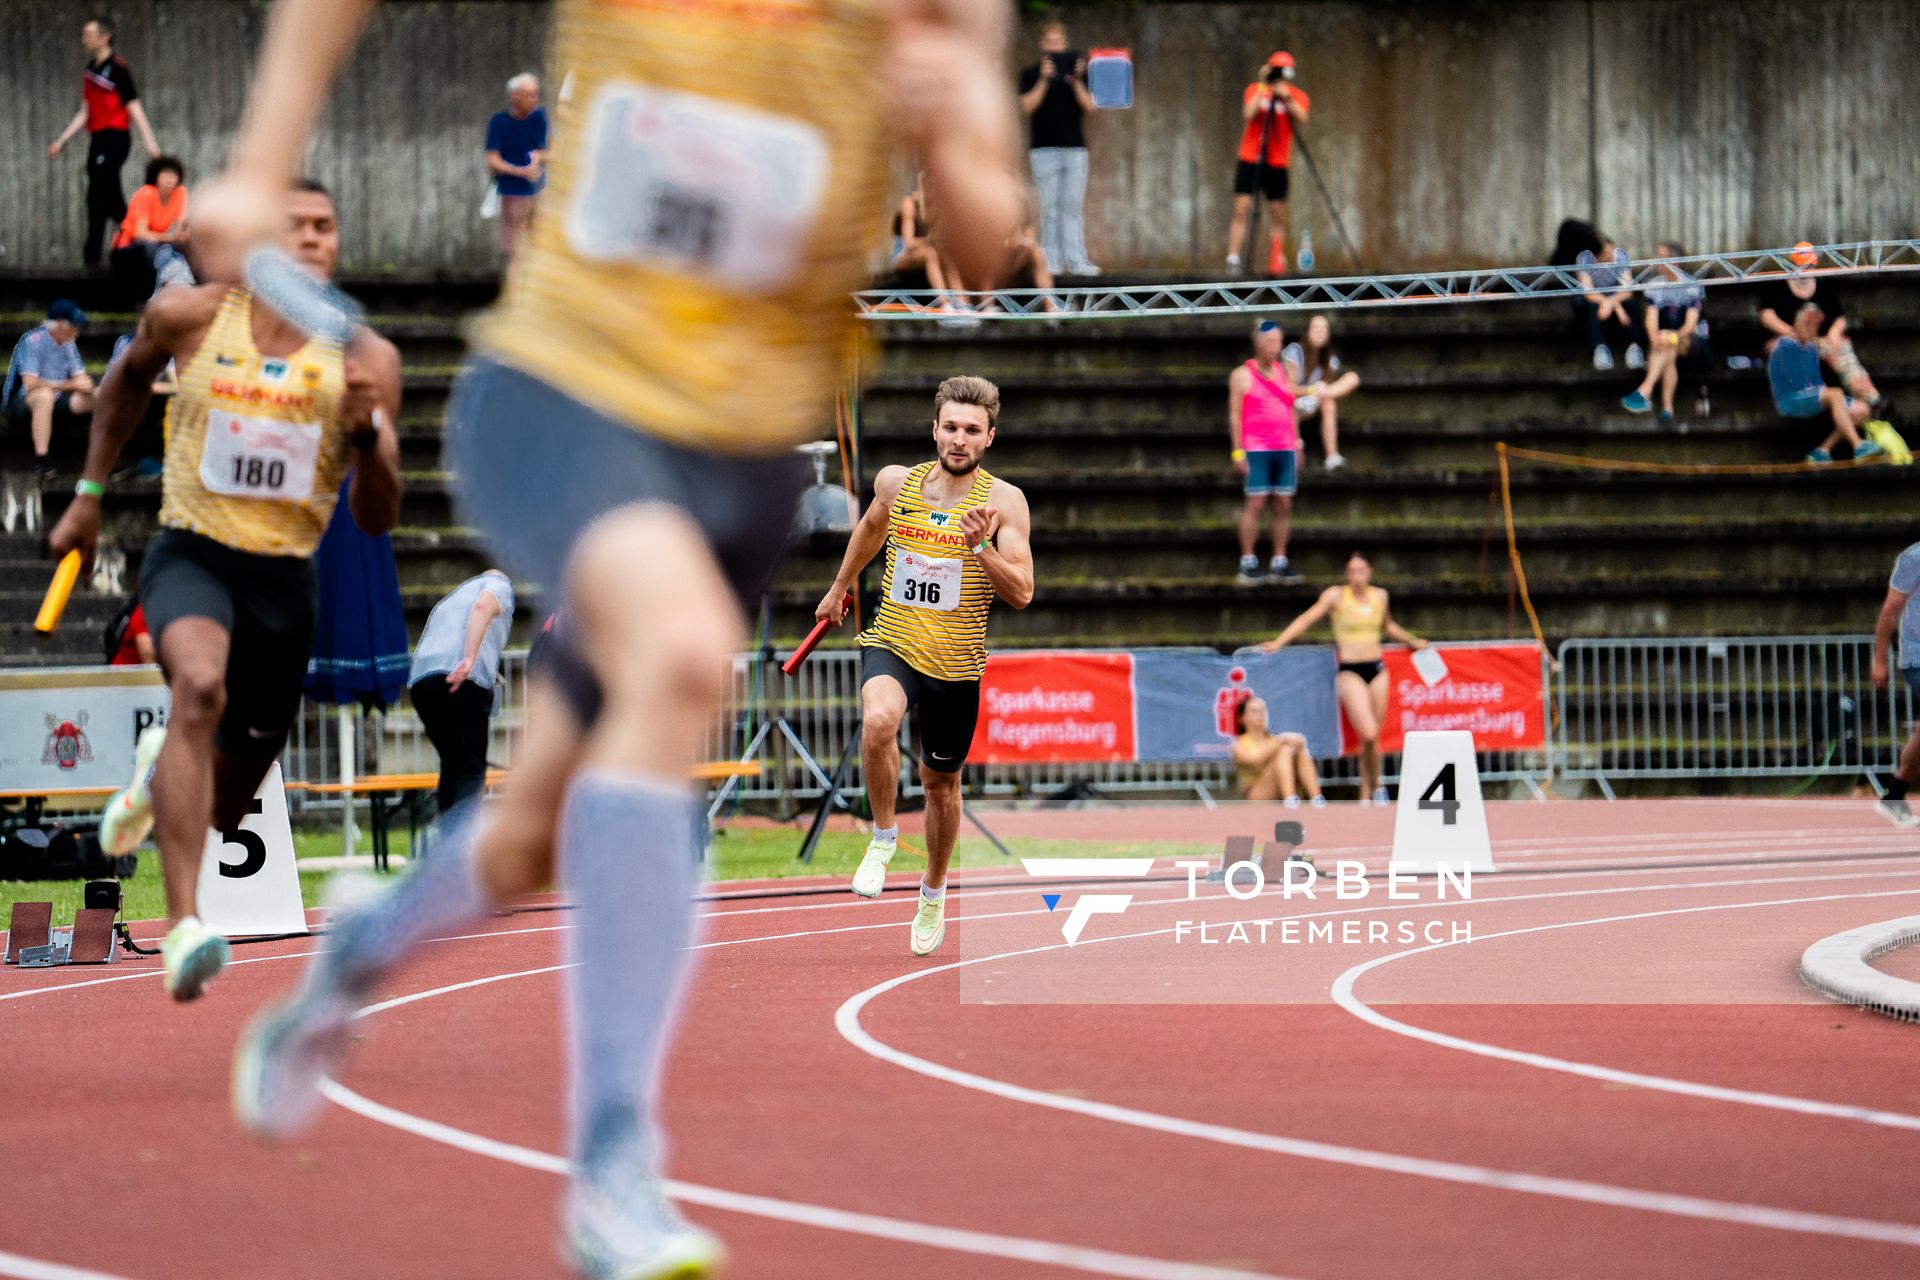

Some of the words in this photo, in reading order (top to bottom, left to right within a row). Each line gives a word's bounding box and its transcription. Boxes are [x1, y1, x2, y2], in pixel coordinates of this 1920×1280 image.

[233, 456, 286, 488] 180
[904, 579, 941, 604] 316
[986, 687, 1094, 717] Sparkasse
[1399, 681, 1504, 707] Sparkasse
[988, 717, 1117, 750] Regensburg
[1418, 763, 1460, 825] 4
[219, 798, 266, 878] 5
